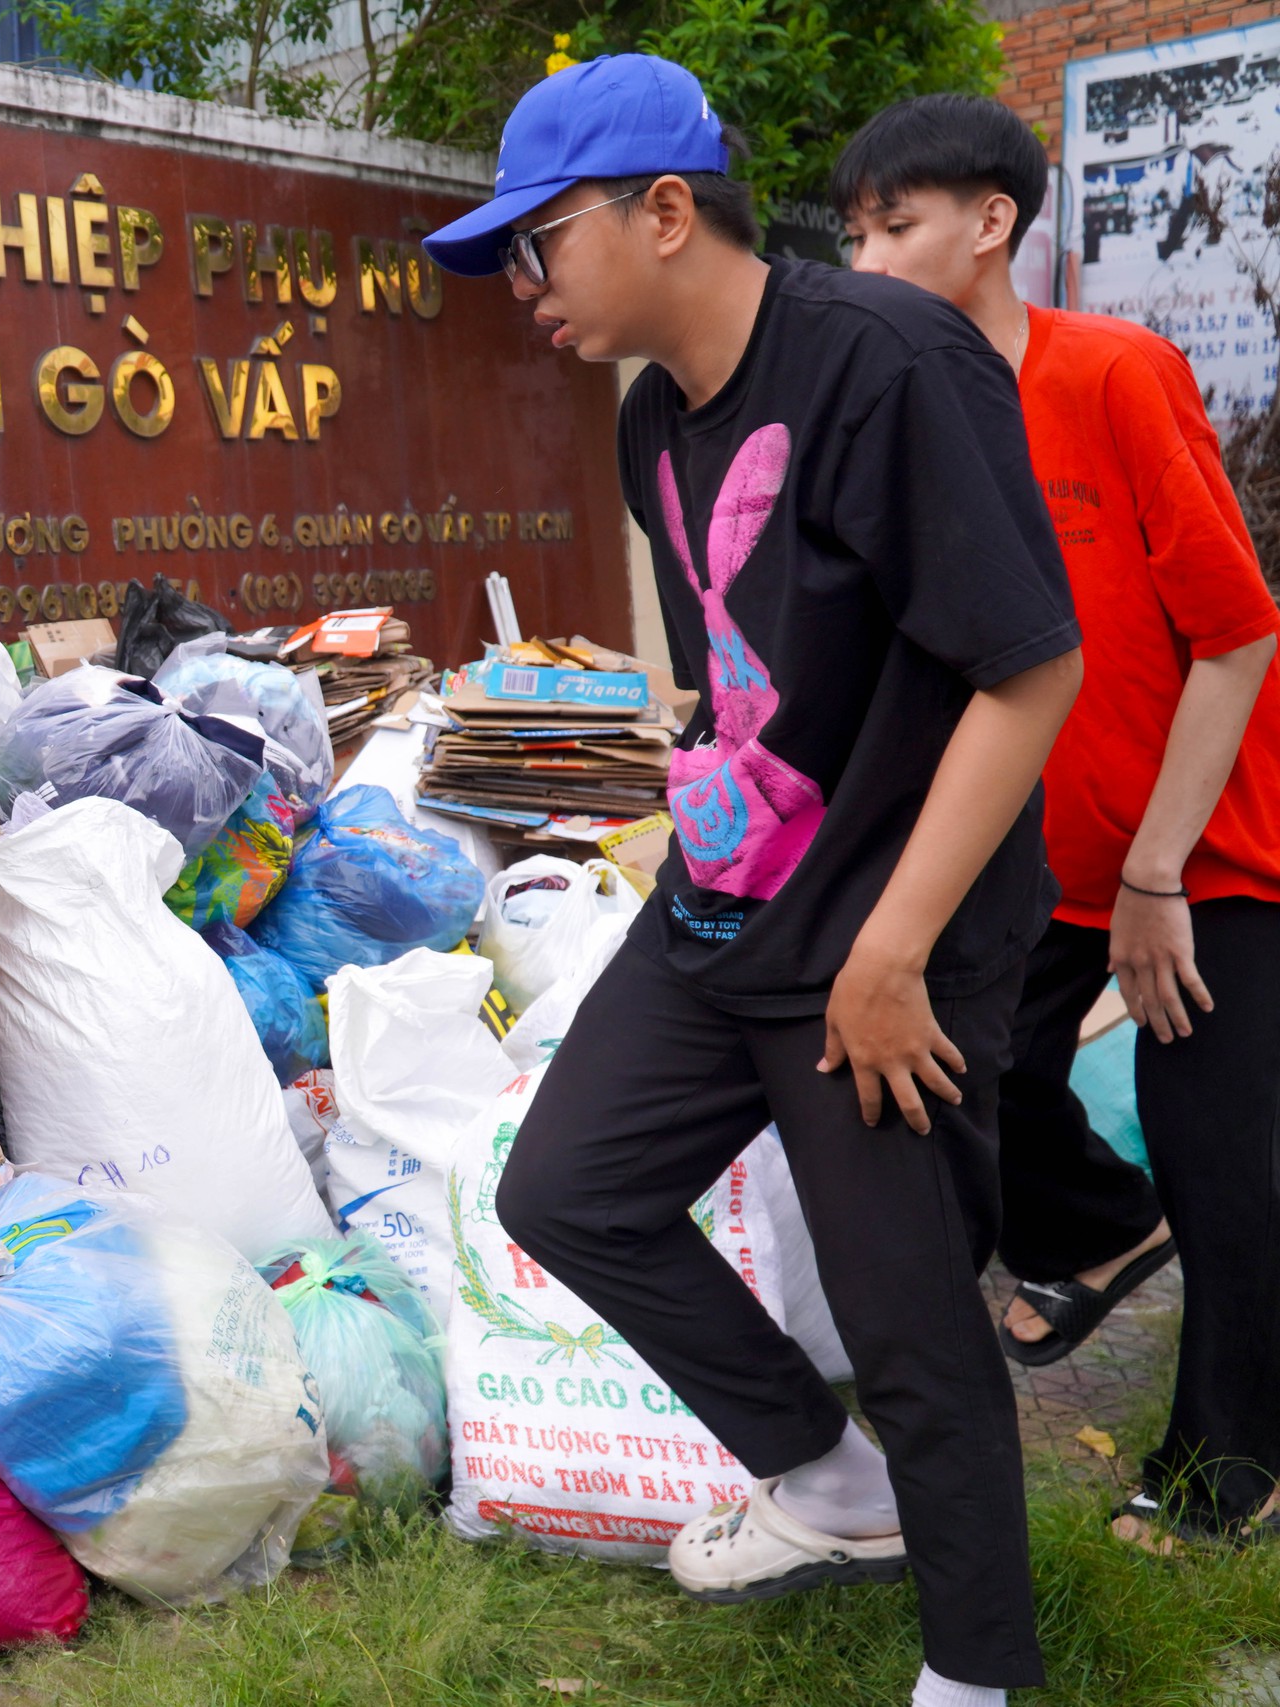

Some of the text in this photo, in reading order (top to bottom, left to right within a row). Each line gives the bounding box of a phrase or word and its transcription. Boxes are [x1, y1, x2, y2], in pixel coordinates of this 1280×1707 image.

[188, 213, 337, 334] PHỤ
[34, 314, 176, 438] GÒ
[196, 320, 343, 442] VẤP
[112, 495, 254, 552] PHƯỜNG
[703, 920, 741, 930] BY TOYS
[380, 1211, 413, 1238] 50
[476, 1371, 545, 1408] GẠO
[554, 1376, 629, 1410] CAO
[462, 1412, 519, 1447] CHẤT
[526, 1425, 611, 1459] LƯỢNG
[616, 1433, 708, 1470] TUYỆT
[465, 1453, 546, 1489] HƯƠNG
[554, 1466, 632, 1498] THƠM
